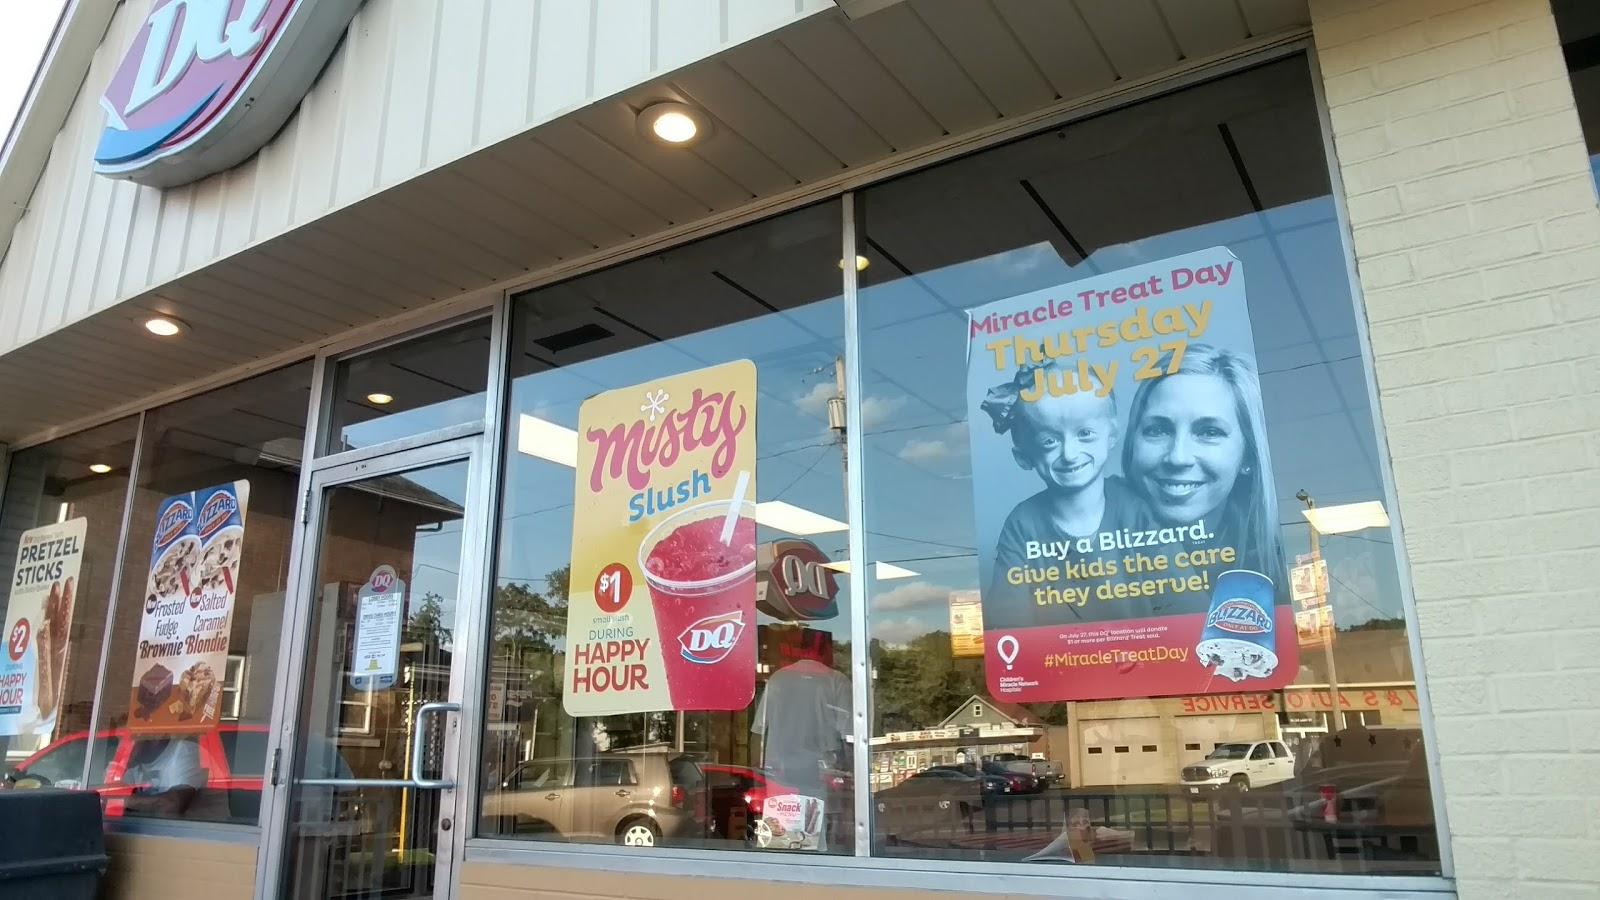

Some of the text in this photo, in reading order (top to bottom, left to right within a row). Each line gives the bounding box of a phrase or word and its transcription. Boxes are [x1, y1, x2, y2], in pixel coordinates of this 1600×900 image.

[124, 0, 269, 117] DQ
[970, 261, 1234, 338] Miracle Treat Day
[985, 299, 1213, 371] Thursday
[1020, 340, 1188, 403] July 27
[586, 388, 747, 493] Misty
[629, 469, 712, 522] Slush
[20, 536, 79, 565] PRETZEL
[1025, 520, 1214, 560] Buy a Blizzard.
[16, 561, 63, 587] STICKS
[1007, 546, 1236, 585] Give kids the care
[374, 574, 391, 587] DQ
[600, 570, 621, 603] $1
[1034, 570, 1210, 607] they deserve!
[155, 597, 187, 617] Frosted
[199, 591, 228, 612] Salted
[155, 619, 179, 640] Fudge
[193, 611, 229, 632] Caramel
[589, 626, 633, 641] DURING
[1207, 605, 1273, 634] BLIZZARD
[12, 625, 27, 653] $2
[140, 636, 184, 659] Brownie
[185, 632, 228, 655] Blondie
[690, 622, 736, 651] DQ
[574, 638, 650, 665] HAPPY
[1044, 645, 1189, 669] #MiracleTreatDay
[572, 664, 649, 693] HOUR
[777, 801, 801, 812] Snack
